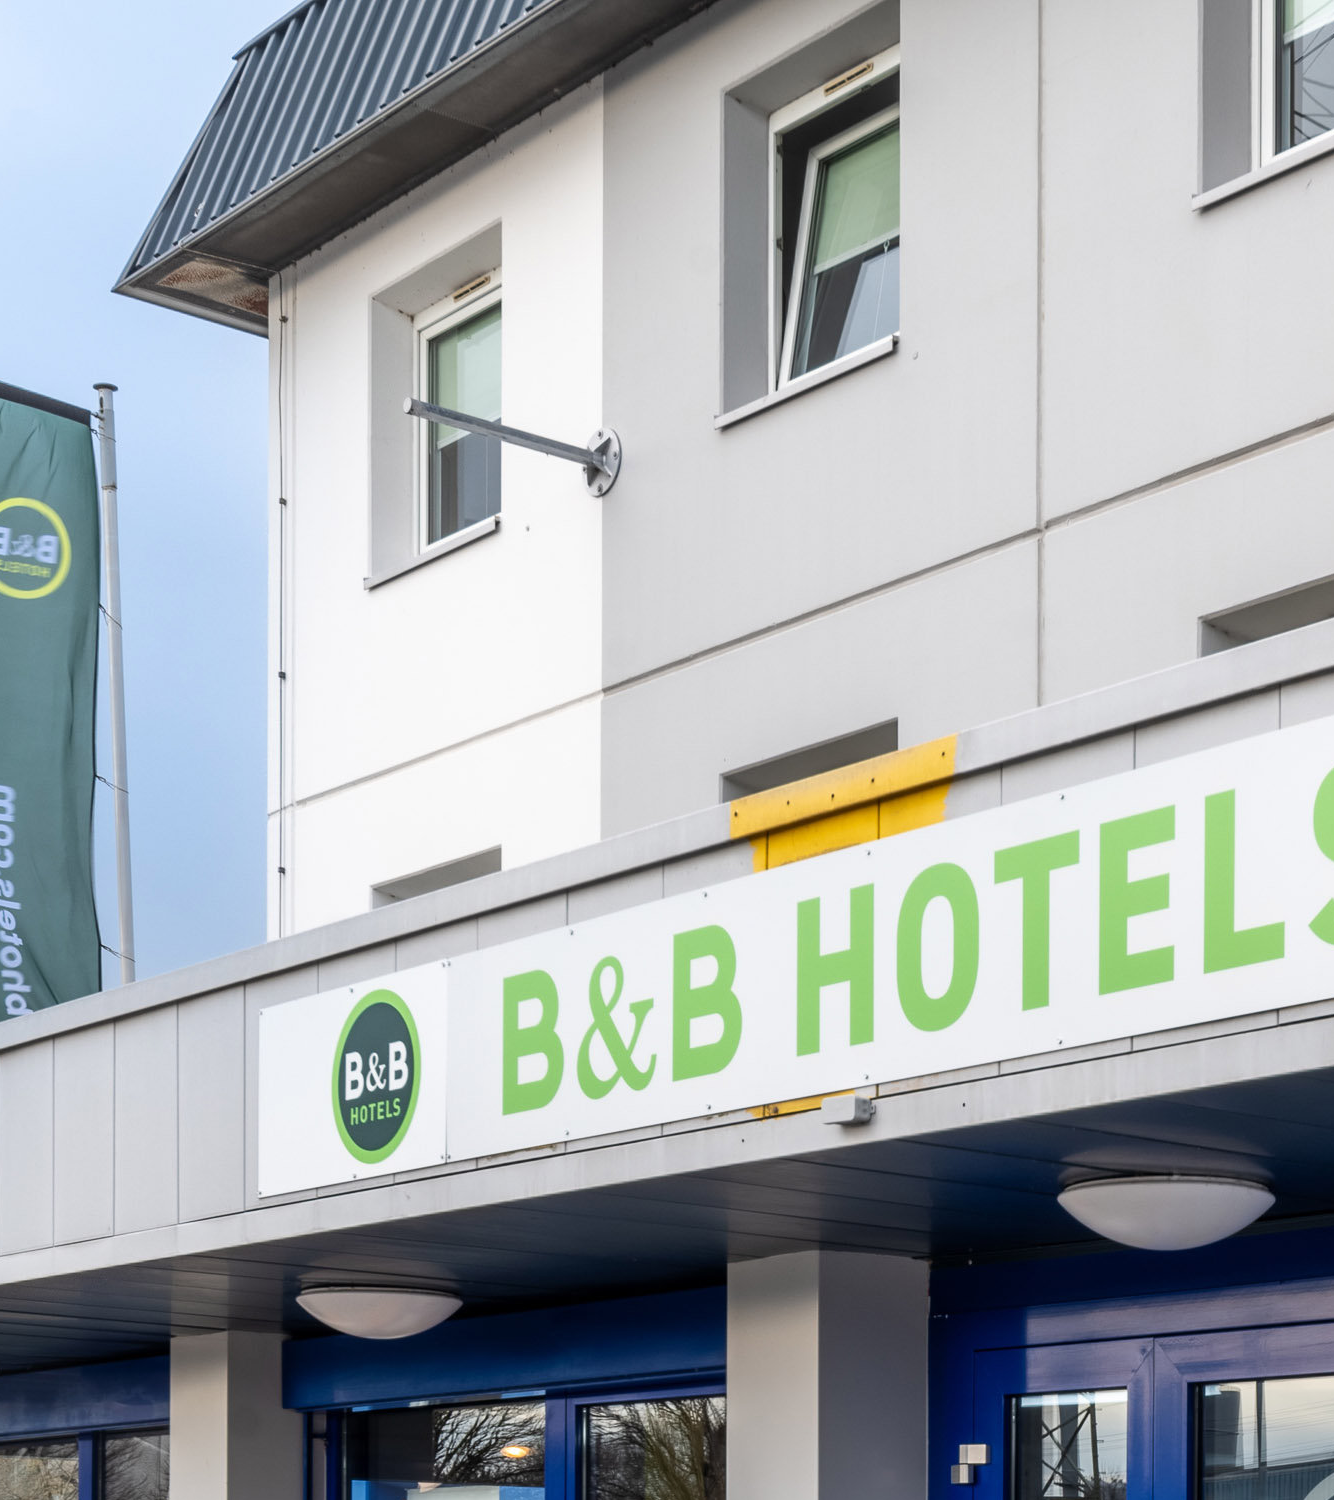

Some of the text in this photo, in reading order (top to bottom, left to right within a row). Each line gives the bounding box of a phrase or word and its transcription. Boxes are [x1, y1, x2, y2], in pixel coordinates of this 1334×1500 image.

[502, 923, 742, 1116] B&B
[344, 1040, 409, 1101] B&B
[350, 1098, 401, 1126] HOTELS
